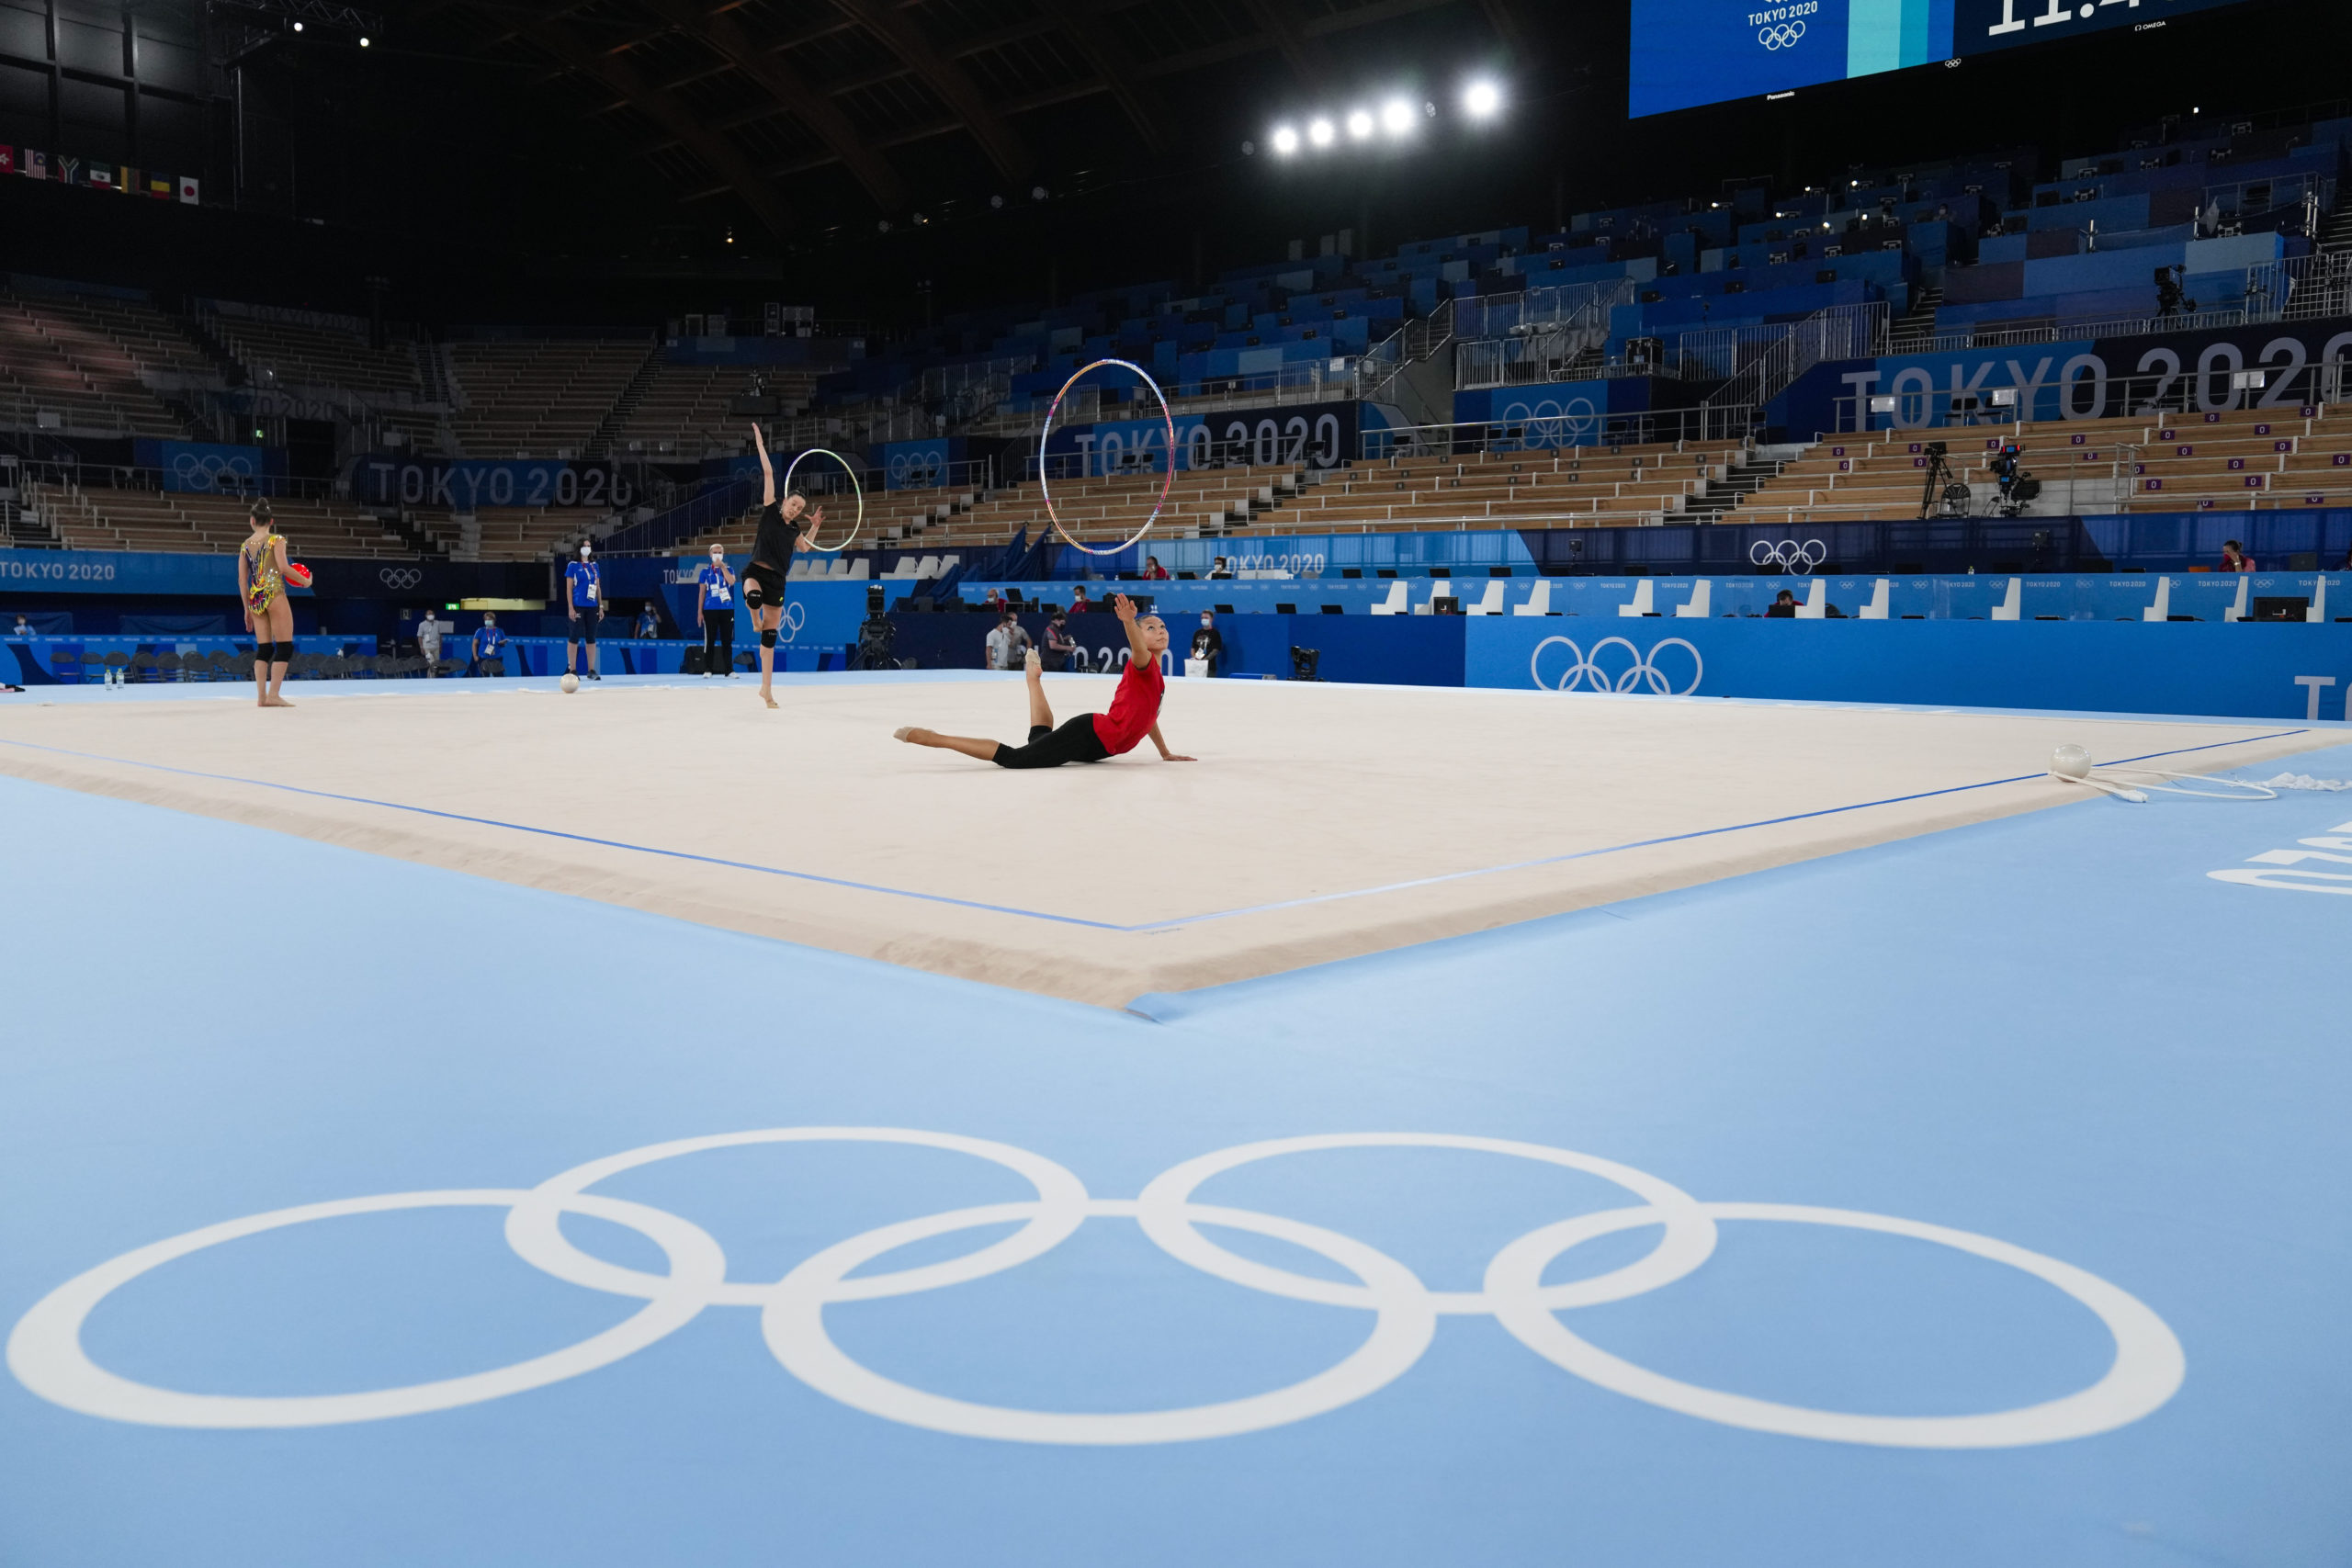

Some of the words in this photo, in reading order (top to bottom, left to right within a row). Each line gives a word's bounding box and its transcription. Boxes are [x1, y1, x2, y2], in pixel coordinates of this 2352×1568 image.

[1747, 7, 1787, 26] TOKYO
[1788, 1, 1818, 18] 2020
[2143, 20, 2166, 29] OMEGA
[1767, 91, 1795, 100] Panasonic
[1841, 354, 2108, 432] TOKYO
[1075, 424, 1212, 478] TOKYO
[1226, 413, 1340, 468] 2020
[369, 462, 514, 505] TOKYO
[526, 468, 632, 505] 2020
[0, 562, 63, 579] TOKYO
[69, 564, 115, 581] 2020
[1226, 554, 1274, 575] OKYO
[1279, 553, 1325, 575] 2020
[2294, 675, 2352, 721] T
